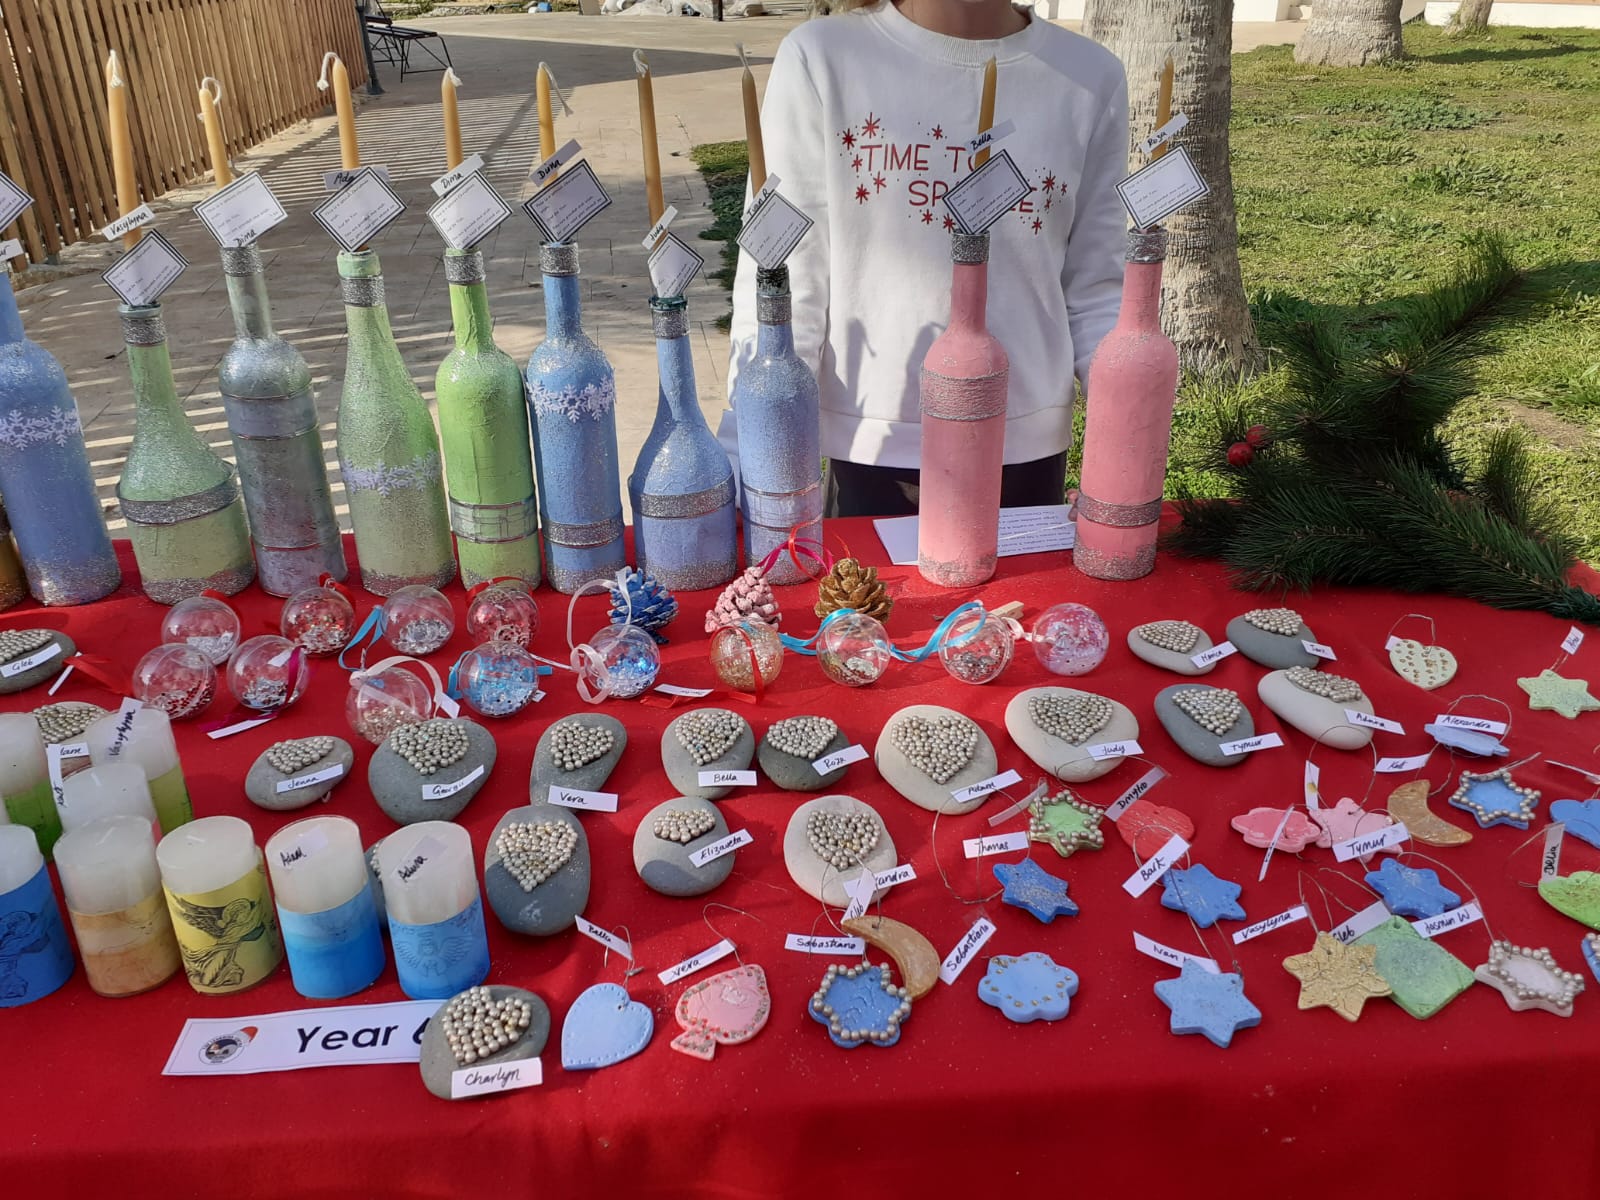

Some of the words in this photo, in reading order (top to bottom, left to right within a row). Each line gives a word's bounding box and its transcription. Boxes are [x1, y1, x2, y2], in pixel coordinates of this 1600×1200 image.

[970, 132, 994, 151] Bella
[860, 144, 931, 172] TIME
[946, 146, 974, 173] T
[713, 772, 738, 783] Bella
[560, 793, 589, 806] Vera
[1349, 834, 1387, 856] Tymur
[1452, 909, 1470, 922] W
[297, 1025, 399, 1054] Year
